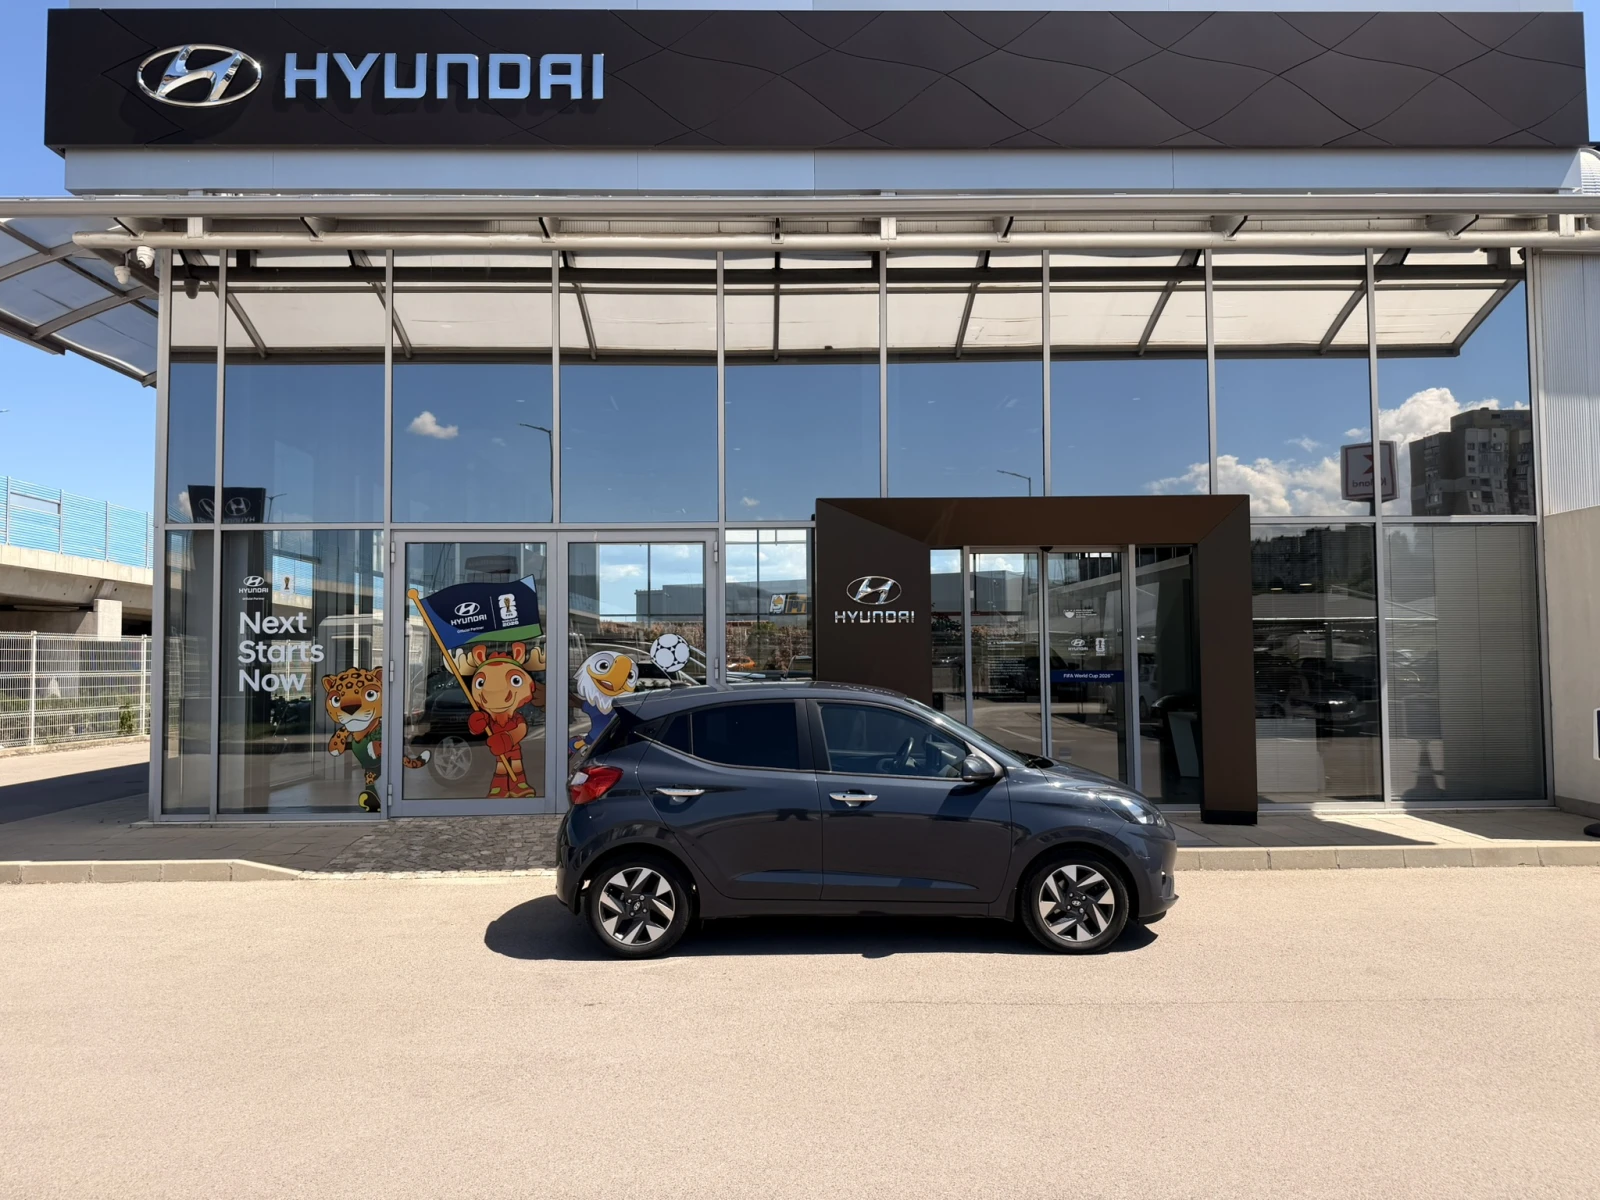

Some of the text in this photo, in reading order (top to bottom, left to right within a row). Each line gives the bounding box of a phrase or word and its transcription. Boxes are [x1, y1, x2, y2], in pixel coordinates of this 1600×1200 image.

[284, 52, 605, 100] HYUNDAI
[240, 611, 307, 634] Next
[450, 614, 487, 626] HYUNDAI
[834, 610, 915, 624] HYUNDAI
[237, 640, 325, 664] Starts
[238, 669, 307, 692] Now
